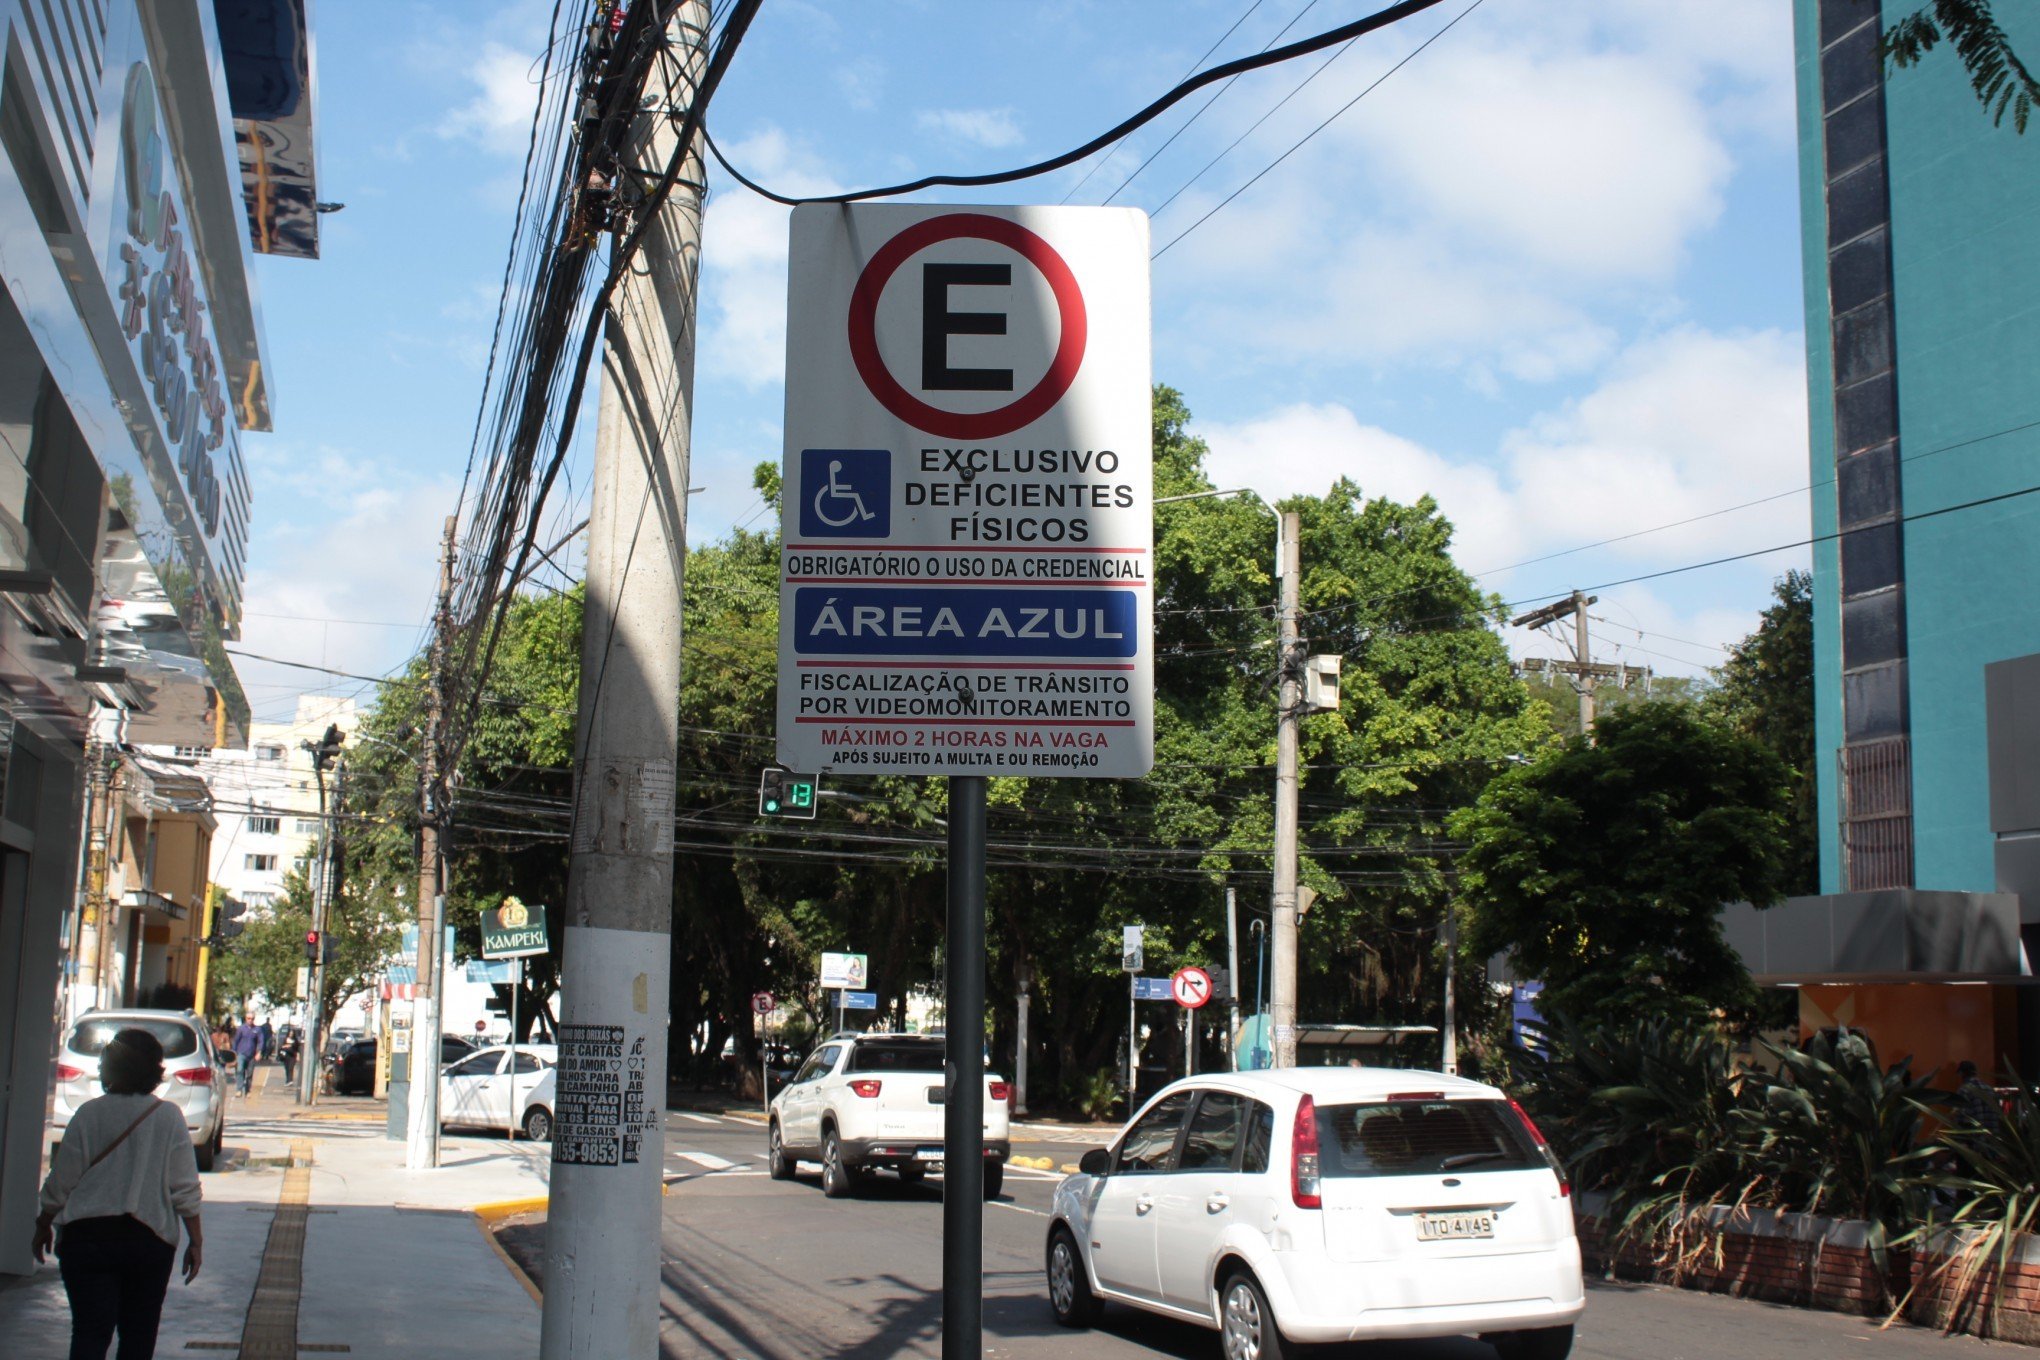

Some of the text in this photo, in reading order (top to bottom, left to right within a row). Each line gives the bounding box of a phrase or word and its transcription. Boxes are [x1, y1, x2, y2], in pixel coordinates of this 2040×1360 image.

[922, 263, 1013, 391] E
[921, 448, 1118, 474] EXCLUSIVO
[905, 483, 1133, 508] DEFICIENTES
[951, 511, 1089, 542] FÍSICOS
[788, 552, 1144, 579] OBRIGATÓRIO O USO DA CREDENCIAL
[810, 597, 1123, 639] ÁREA AZUL
[800, 672, 1129, 695] FISCALIZAÇÃO DE TRÂNSITO
[800, 697, 1130, 717] POR VIDEOMONITORAMENTO
[821, 726, 1109, 748] MÁXIMO 2 HORAS NA VAGA
[832, 748, 1099, 769] APÓS SUJEITO A MULTA E OU REMOÇÃO
[791, 784, 811, 806] 13
[485, 931, 543, 950] KAMPEKI
[565, 1044, 575, 1056] DE
[578, 1044, 622, 1057] CARTAS
[579, 1059, 606, 1071] AMOR
[567, 1082, 619, 1092] CAMINHO
[590, 1073, 619, 1083] PARA
[587, 1115, 617, 1125] FINS
[588, 1105, 617, 1115] PARA
[577, 1126, 617, 1137] CASAIS
